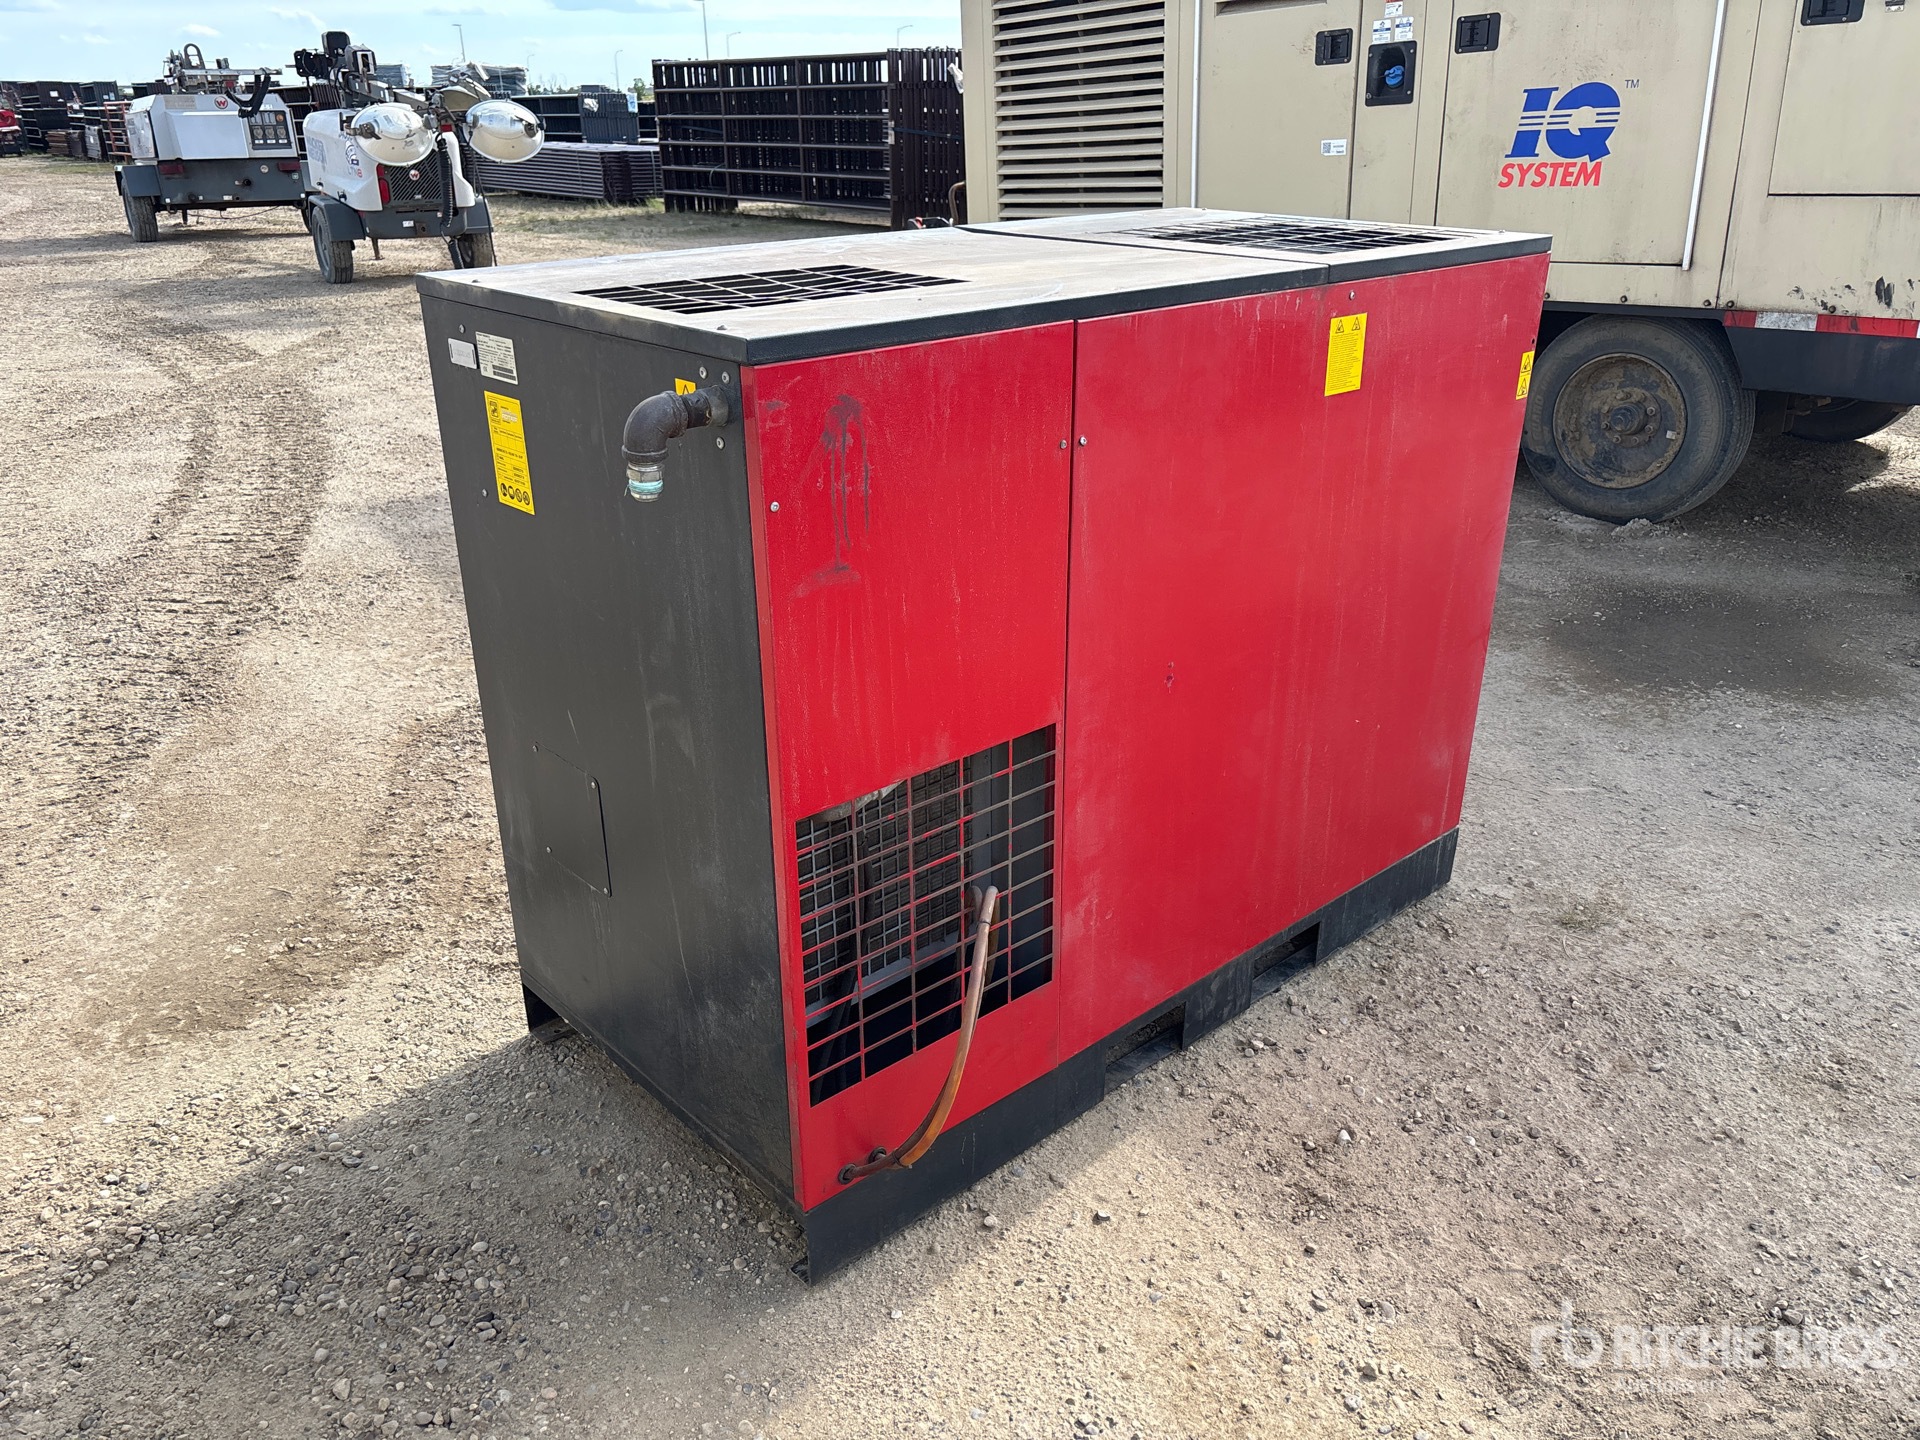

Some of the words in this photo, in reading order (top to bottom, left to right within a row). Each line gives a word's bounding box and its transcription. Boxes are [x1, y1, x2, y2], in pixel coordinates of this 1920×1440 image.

[1625, 79, 1639, 88] TM
[1505, 82, 1620, 162] IQ
[1498, 161, 1602, 188] SYSTEM
